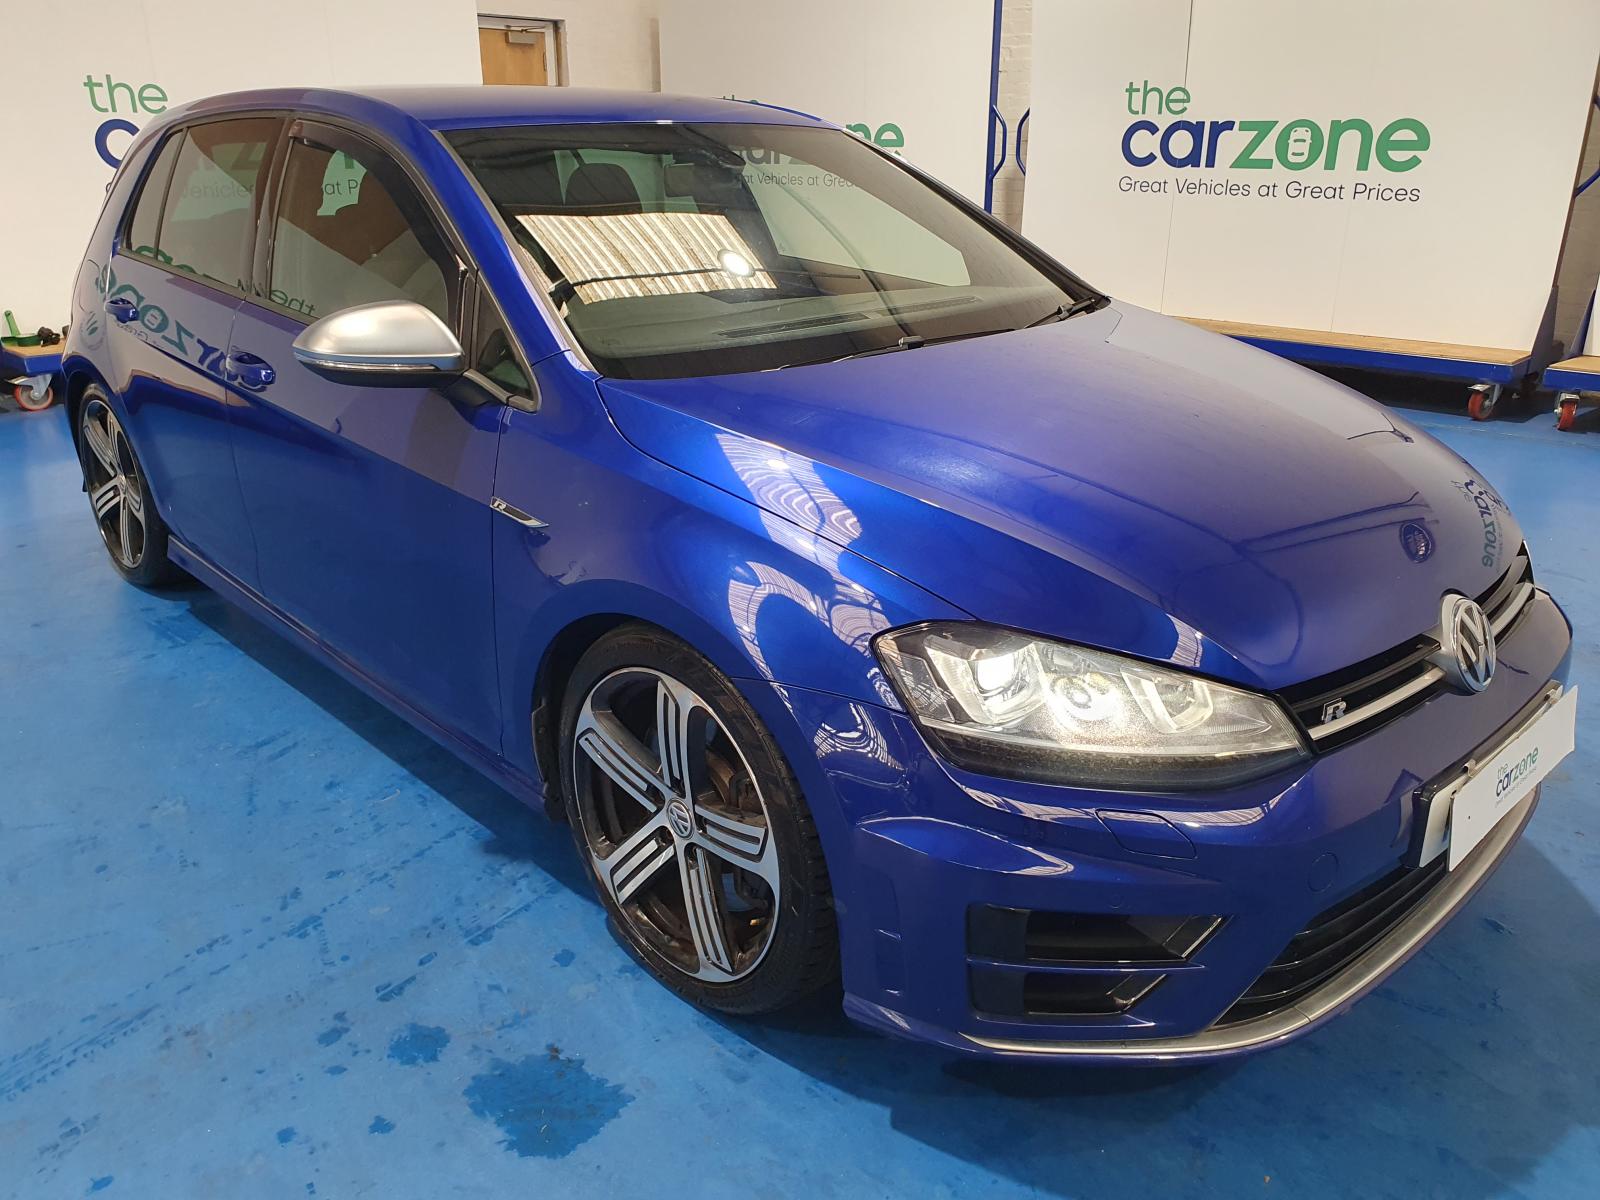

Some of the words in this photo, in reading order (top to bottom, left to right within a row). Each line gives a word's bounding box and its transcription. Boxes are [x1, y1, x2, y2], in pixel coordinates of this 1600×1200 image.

[83, 74, 168, 114] the
[1125, 80, 1191, 115] the
[1121, 116, 1431, 173] carzone
[756, 171, 804, 186] Vehicles
[807, 173, 820, 187] at
[1118, 175, 1169, 194] Great
[1175, 177, 1251, 197] Vehicles
[1257, 182, 1279, 198] at
[1285, 180, 1345, 200] Great
[1352, 182, 1421, 202] Prices
[1495, 746, 1539, 797] carzone
